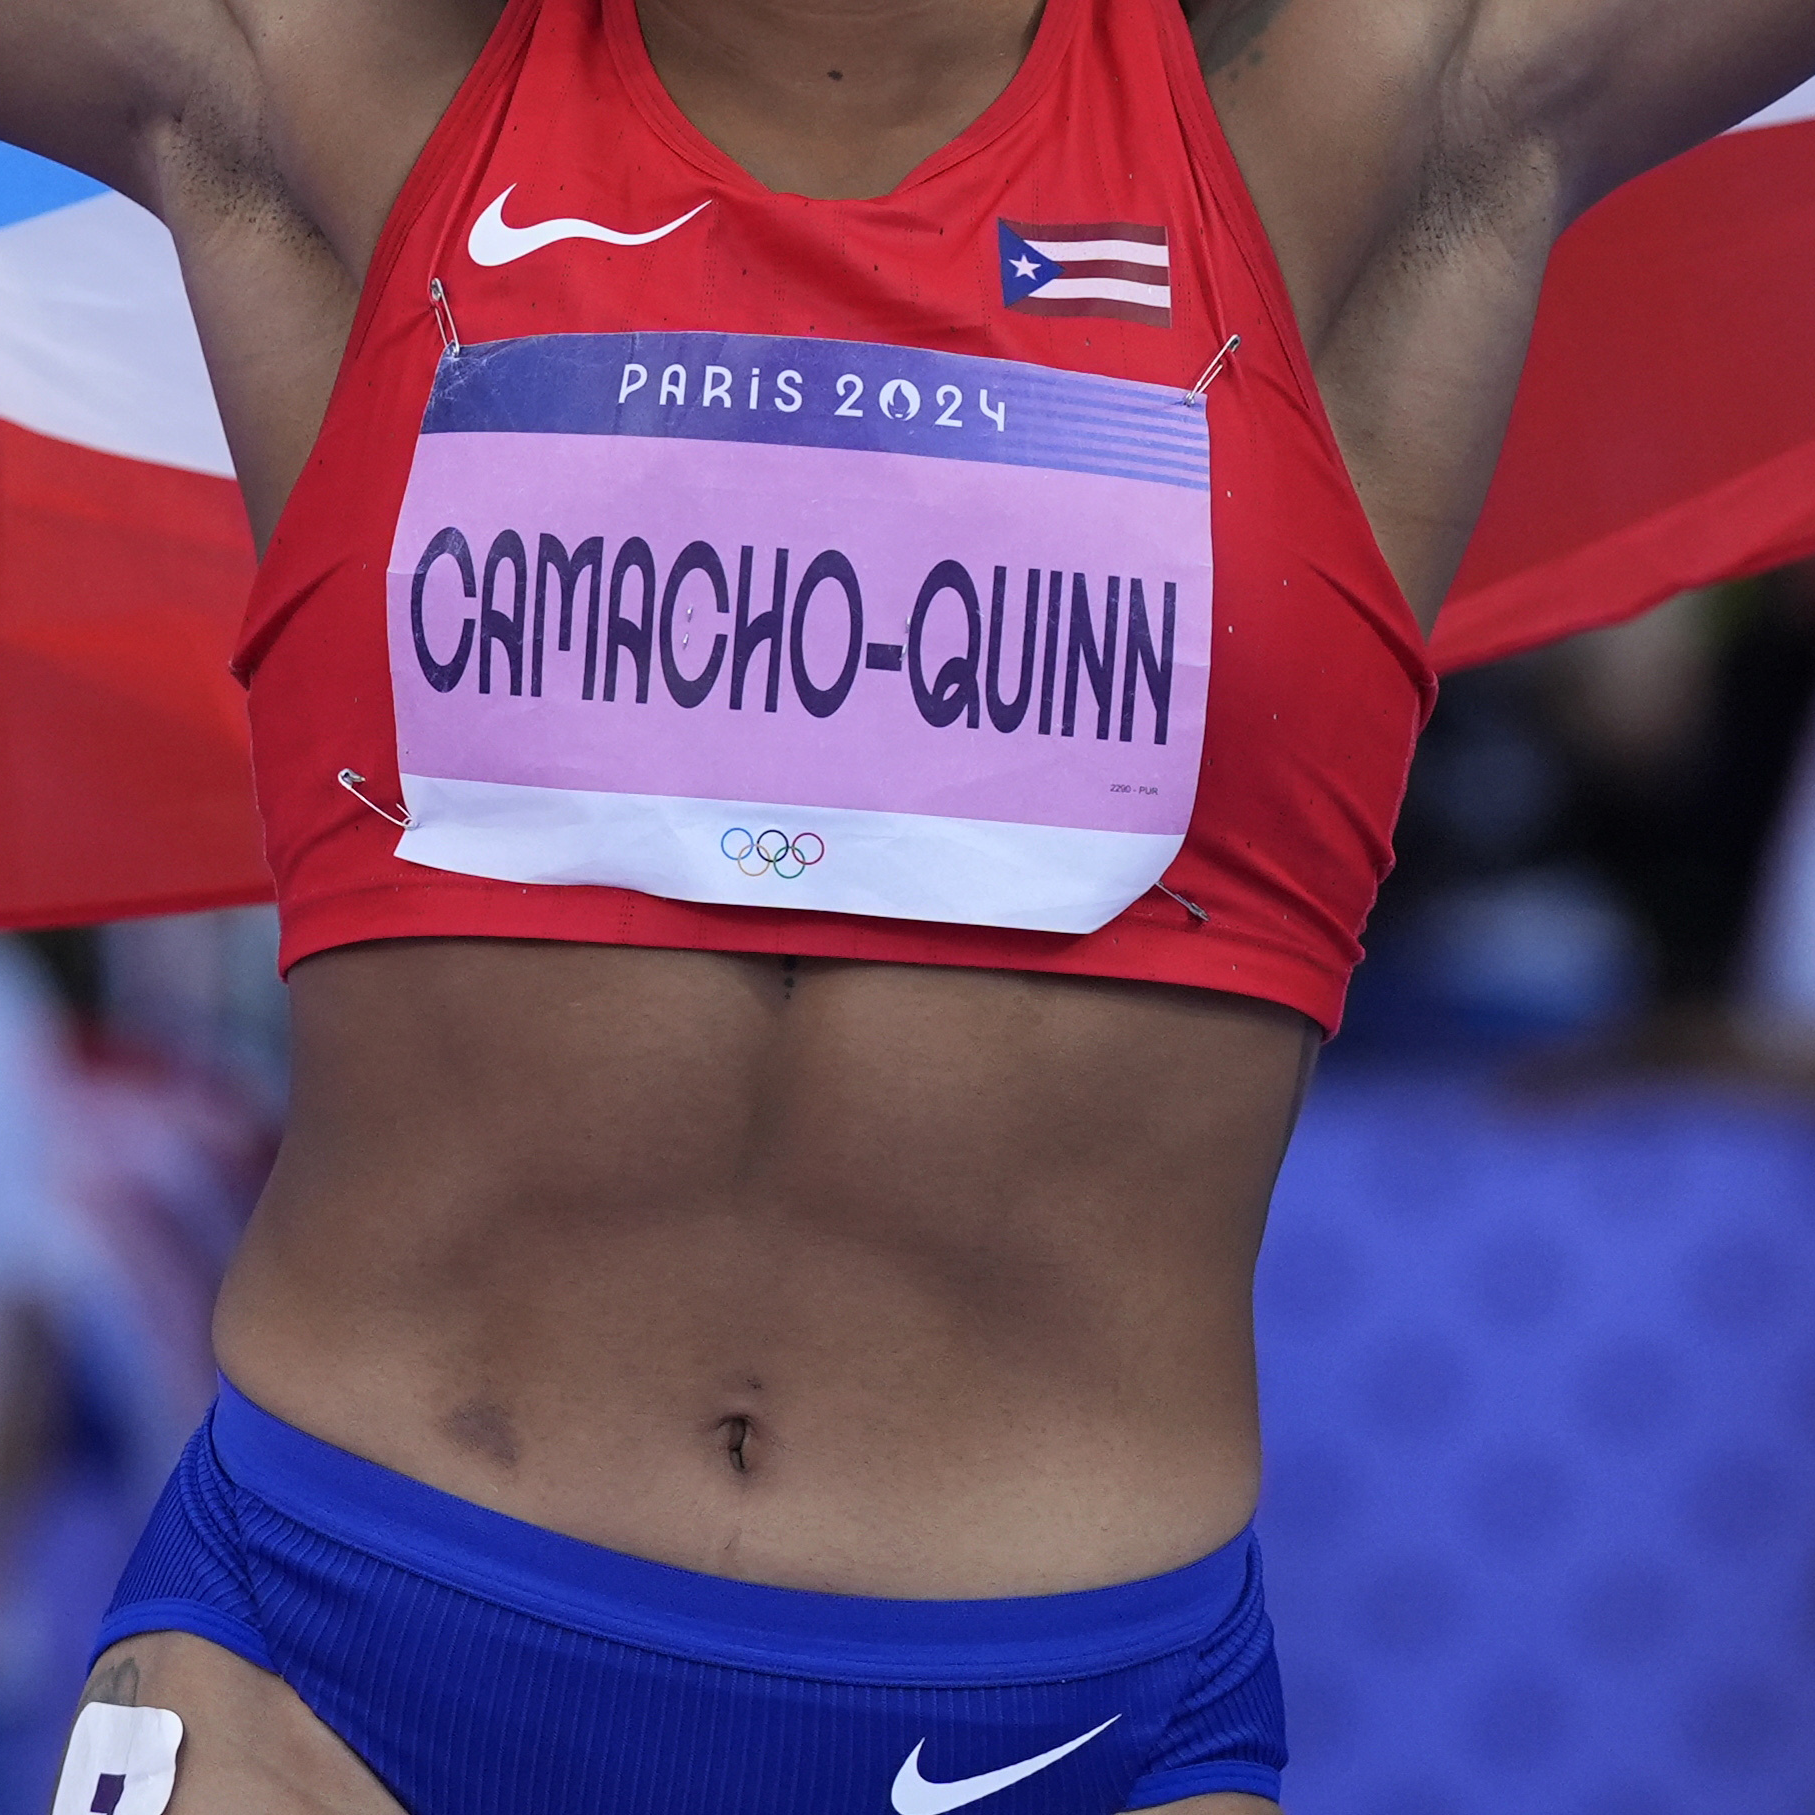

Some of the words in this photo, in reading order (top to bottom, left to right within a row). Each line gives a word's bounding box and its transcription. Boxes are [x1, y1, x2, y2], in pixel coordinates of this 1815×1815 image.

[833, 372, 1007, 433] 2024
[410, 526, 1177, 746] CAMACHO-QUINN
[1138, 785, 1159, 796] PUR
